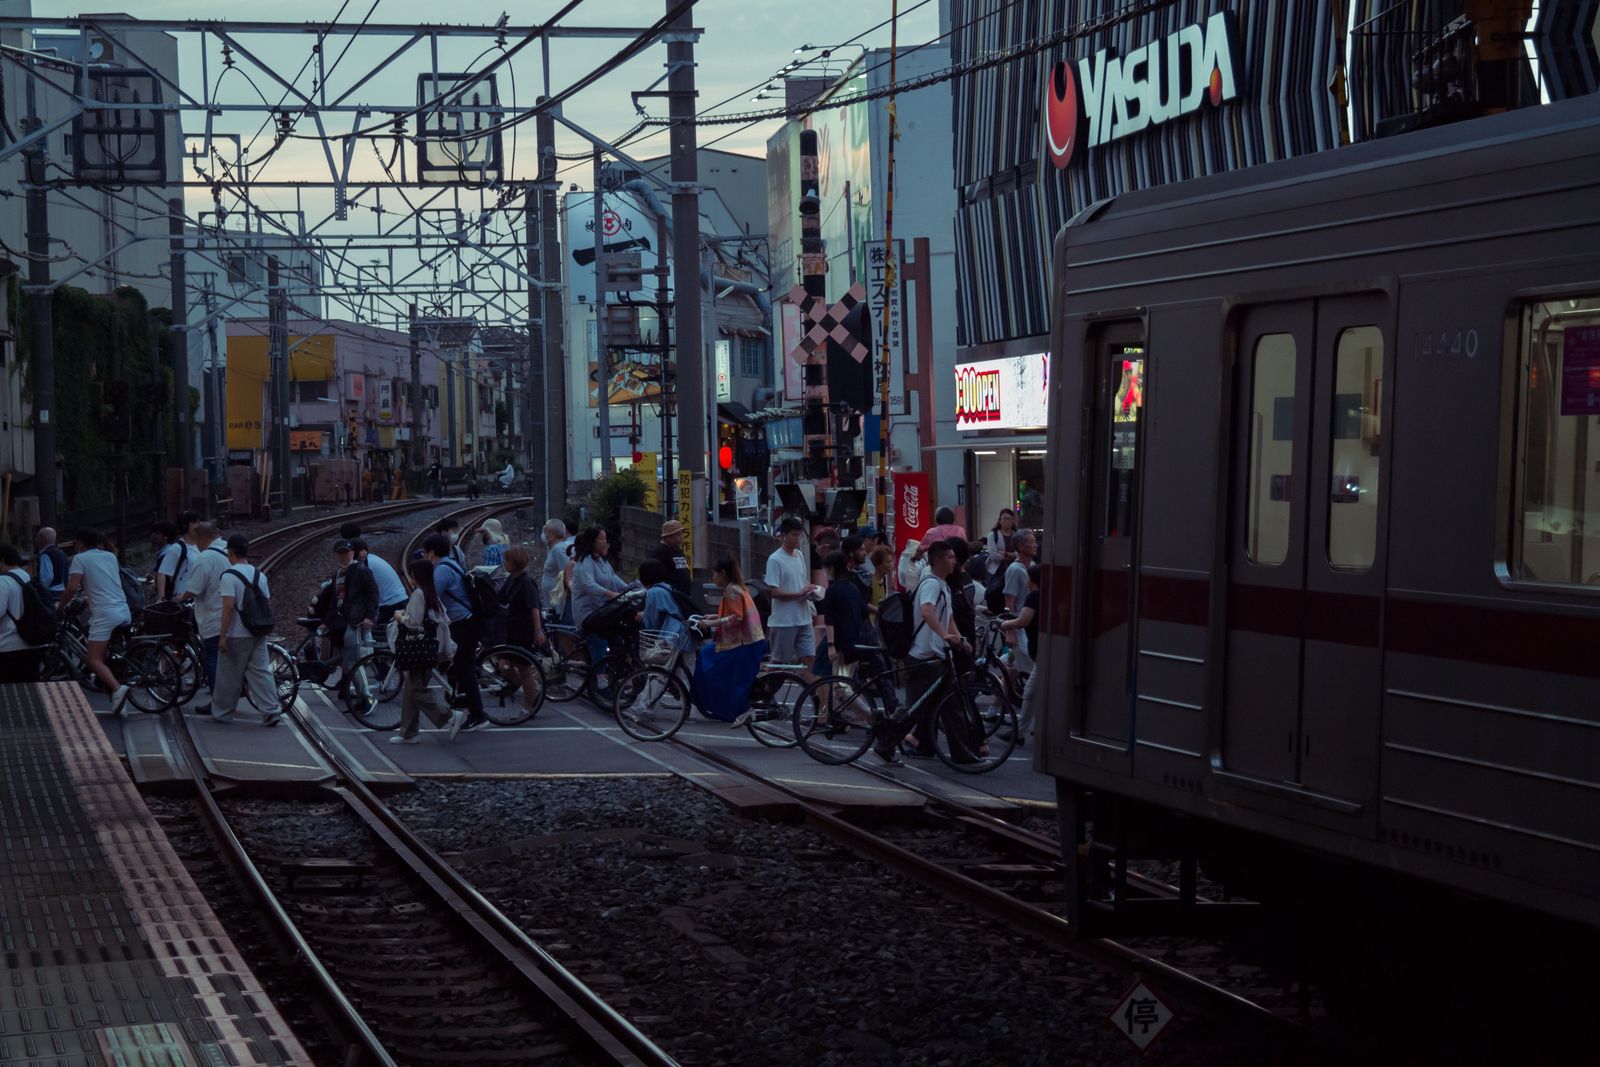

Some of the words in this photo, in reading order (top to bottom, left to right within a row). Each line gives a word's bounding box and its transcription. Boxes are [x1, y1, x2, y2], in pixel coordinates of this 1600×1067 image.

[1078, 11, 1236, 148] YASUDA
[976, 373, 1000, 416] OPEN
[904, 482, 919, 528] Coca-Cola
[1125, 998, 1158, 1034] 停
